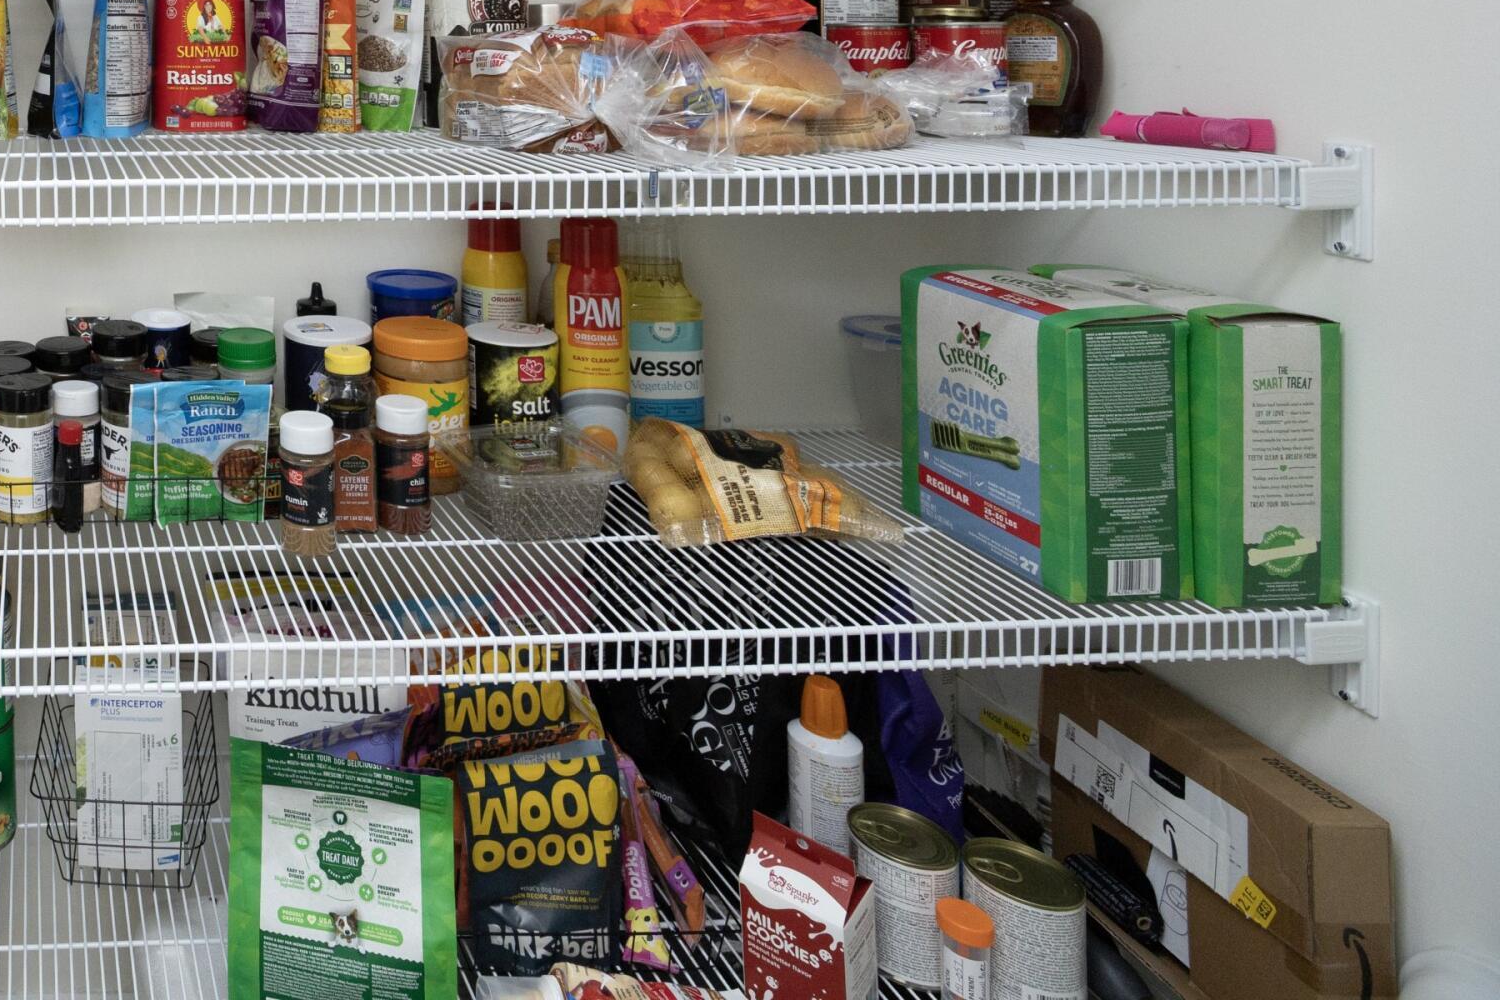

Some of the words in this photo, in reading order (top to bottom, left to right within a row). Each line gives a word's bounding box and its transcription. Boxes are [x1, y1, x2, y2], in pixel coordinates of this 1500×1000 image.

[166, 70, 234, 86] Raisins
[569, 295, 621, 329] PAM
[573, 332, 618, 341] ORIGINAL
[938, 342, 1008, 387] Greenies
[1277, 366, 1288, 375] THE
[1252, 376, 1283, 391] SMART
[1286, 376, 1313, 390] TREAT
[189, 393, 216, 402] Hidden
[938, 376, 1008, 422] AGING
[512, 397, 551, 416] salt
[946, 403, 996, 437] CARE
[181, 423, 242, 437] SEASONING
[171, 437, 205, 445] DRESSING
[213, 433, 237, 441] RECIPE
[339, 476, 370, 484] CAYENNE
[341, 484, 368, 492] PEPPER
[926, 474, 970, 507] REGULAR
[285, 494, 309, 507] cumin
[1020, 555, 1039, 576] 27
[100, 699, 163, 709] INTERCEPTOR
[100, 707, 121, 716] PLUS
[244, 715, 276, 727] Training
[277, 718, 299, 728] Treats
[322, 851, 340, 864] TREAT
[341, 855, 360, 867] DAILY
[786, 882, 819, 906] Spunky
[746, 921, 821, 969] COOKIES
